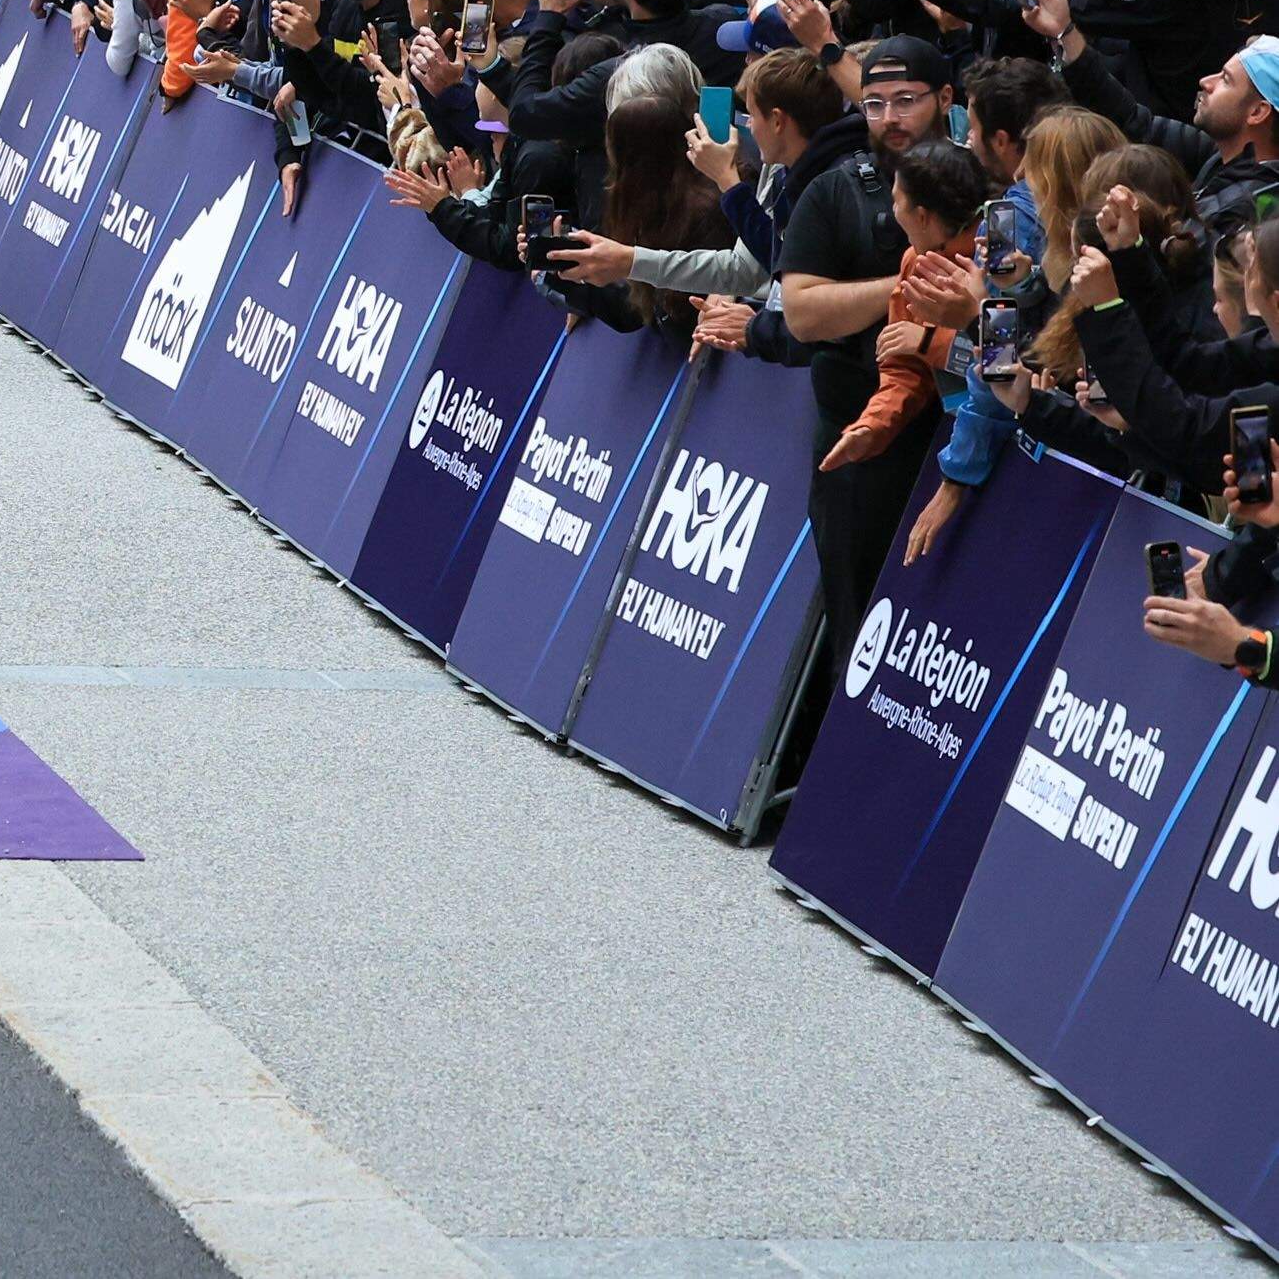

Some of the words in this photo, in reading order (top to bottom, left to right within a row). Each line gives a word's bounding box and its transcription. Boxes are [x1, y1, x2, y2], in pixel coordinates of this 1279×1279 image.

[39, 114, 102, 204] HOKA
[99, 189, 157, 255] DACIA
[225, 295, 297, 384] SUUNTO
[316, 274, 404, 394] HOKA
[435, 376, 460, 424] La
[458, 385, 504, 455] Région
[520, 416, 570, 486] Payot
[563, 436, 613, 504] Pertin
[640, 448, 771, 594] HOKA
[615, 577, 644, 623] FLY
[637, 587, 702, 655] HUMAN
[695, 612, 726, 661] FLY
[885, 607, 915, 674] La
[909, 620, 991, 713] Région
[867, 683, 963, 761] Auvergne-Rhône-Alpes
[1034, 667, 1109, 758] Payot
[1094, 702, 1166, 801] Pertin
[1071, 794, 1126, 863] SUPER
[1113, 821, 1140, 870] U
[1172, 912, 1210, 974] FLY
